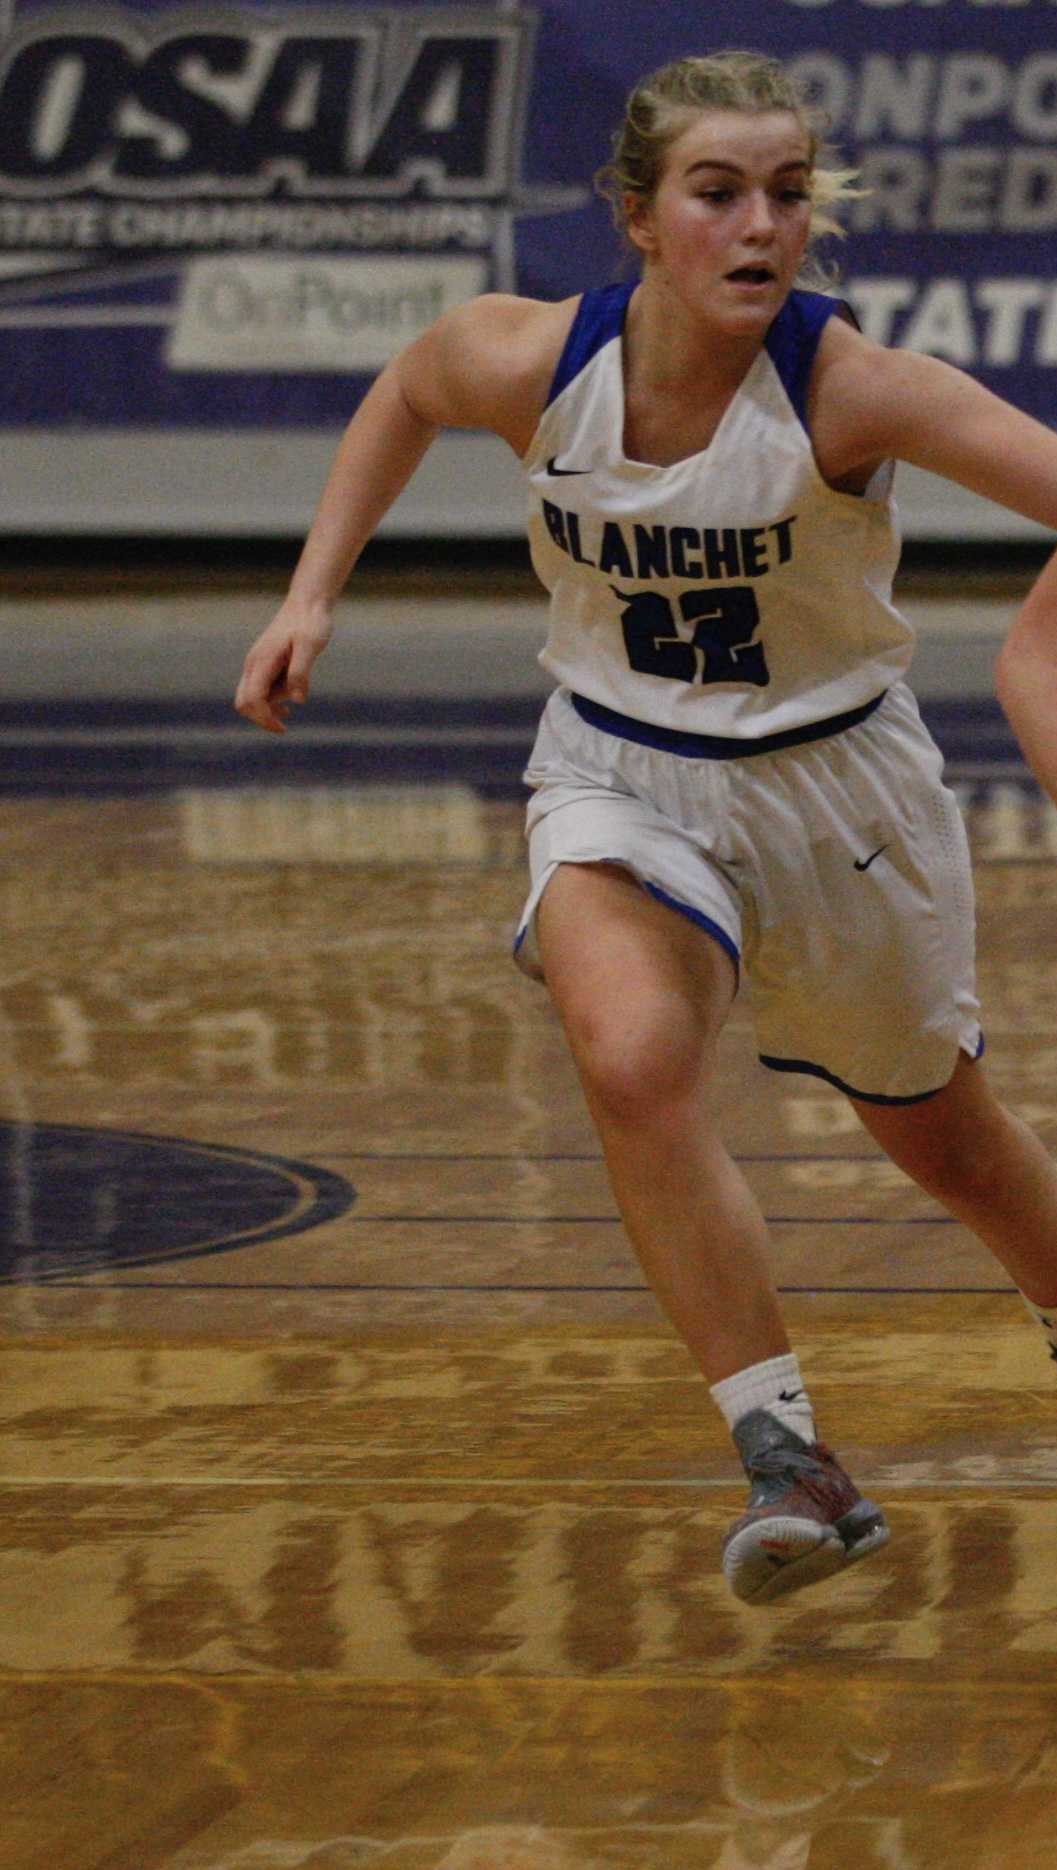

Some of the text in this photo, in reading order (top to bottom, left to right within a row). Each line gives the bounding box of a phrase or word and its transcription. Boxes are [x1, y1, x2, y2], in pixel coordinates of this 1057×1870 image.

[0, 33, 504, 180] OSAA
[541, 498, 798, 580] BLANCHET
[609, 580, 771, 689] 22
